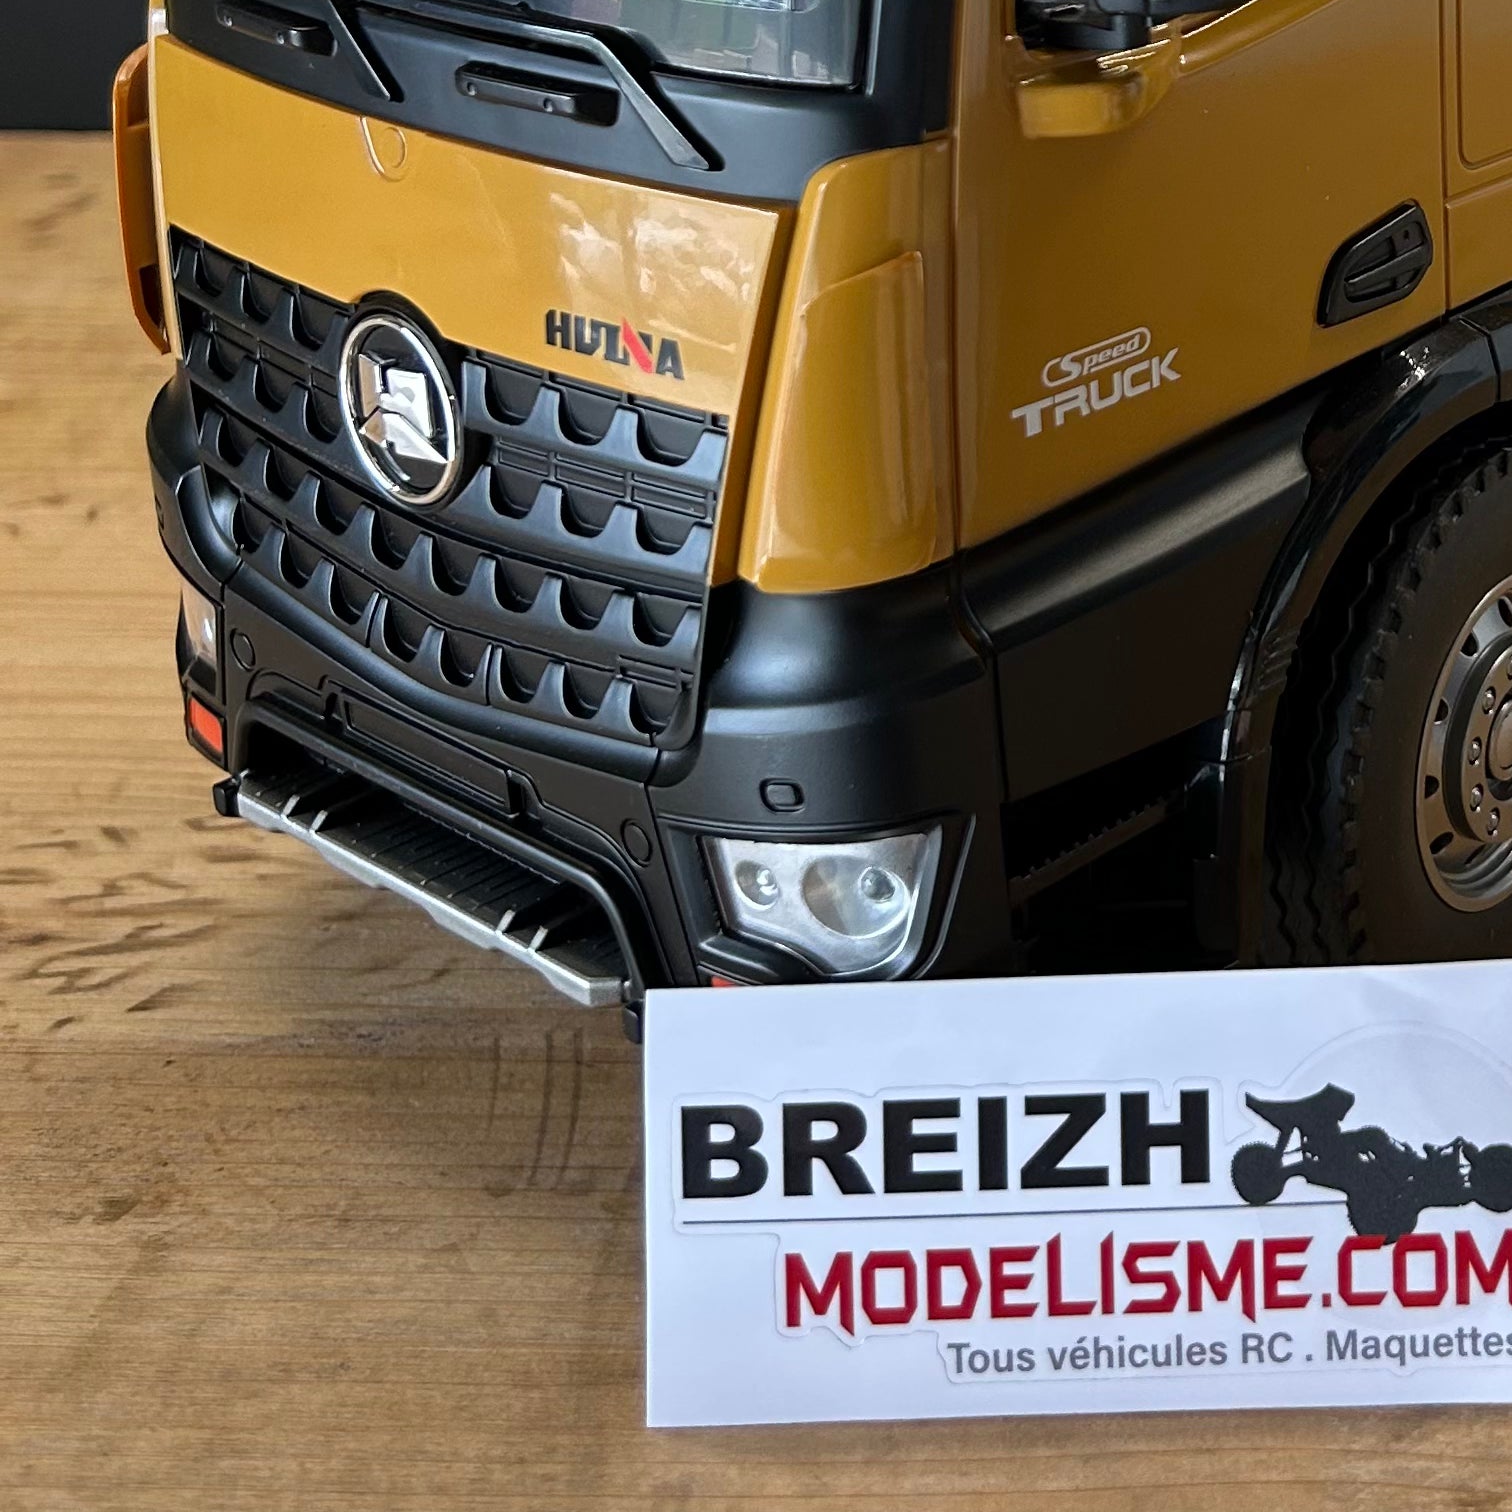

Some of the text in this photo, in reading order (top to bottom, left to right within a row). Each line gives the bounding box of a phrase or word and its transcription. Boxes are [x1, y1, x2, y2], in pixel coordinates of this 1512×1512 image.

[545, 308, 685, 381] HUINA
[1045, 329, 1147, 386] Speed
[1011, 347, 1182, 438] TRUCK
[680, 1090, 1211, 1200] BREIZH
[946, 1342, 1036, 1375] Tous
[1047, 1331, 1228, 1372] véhicules
[1241, 1331, 1294, 1365] RC
